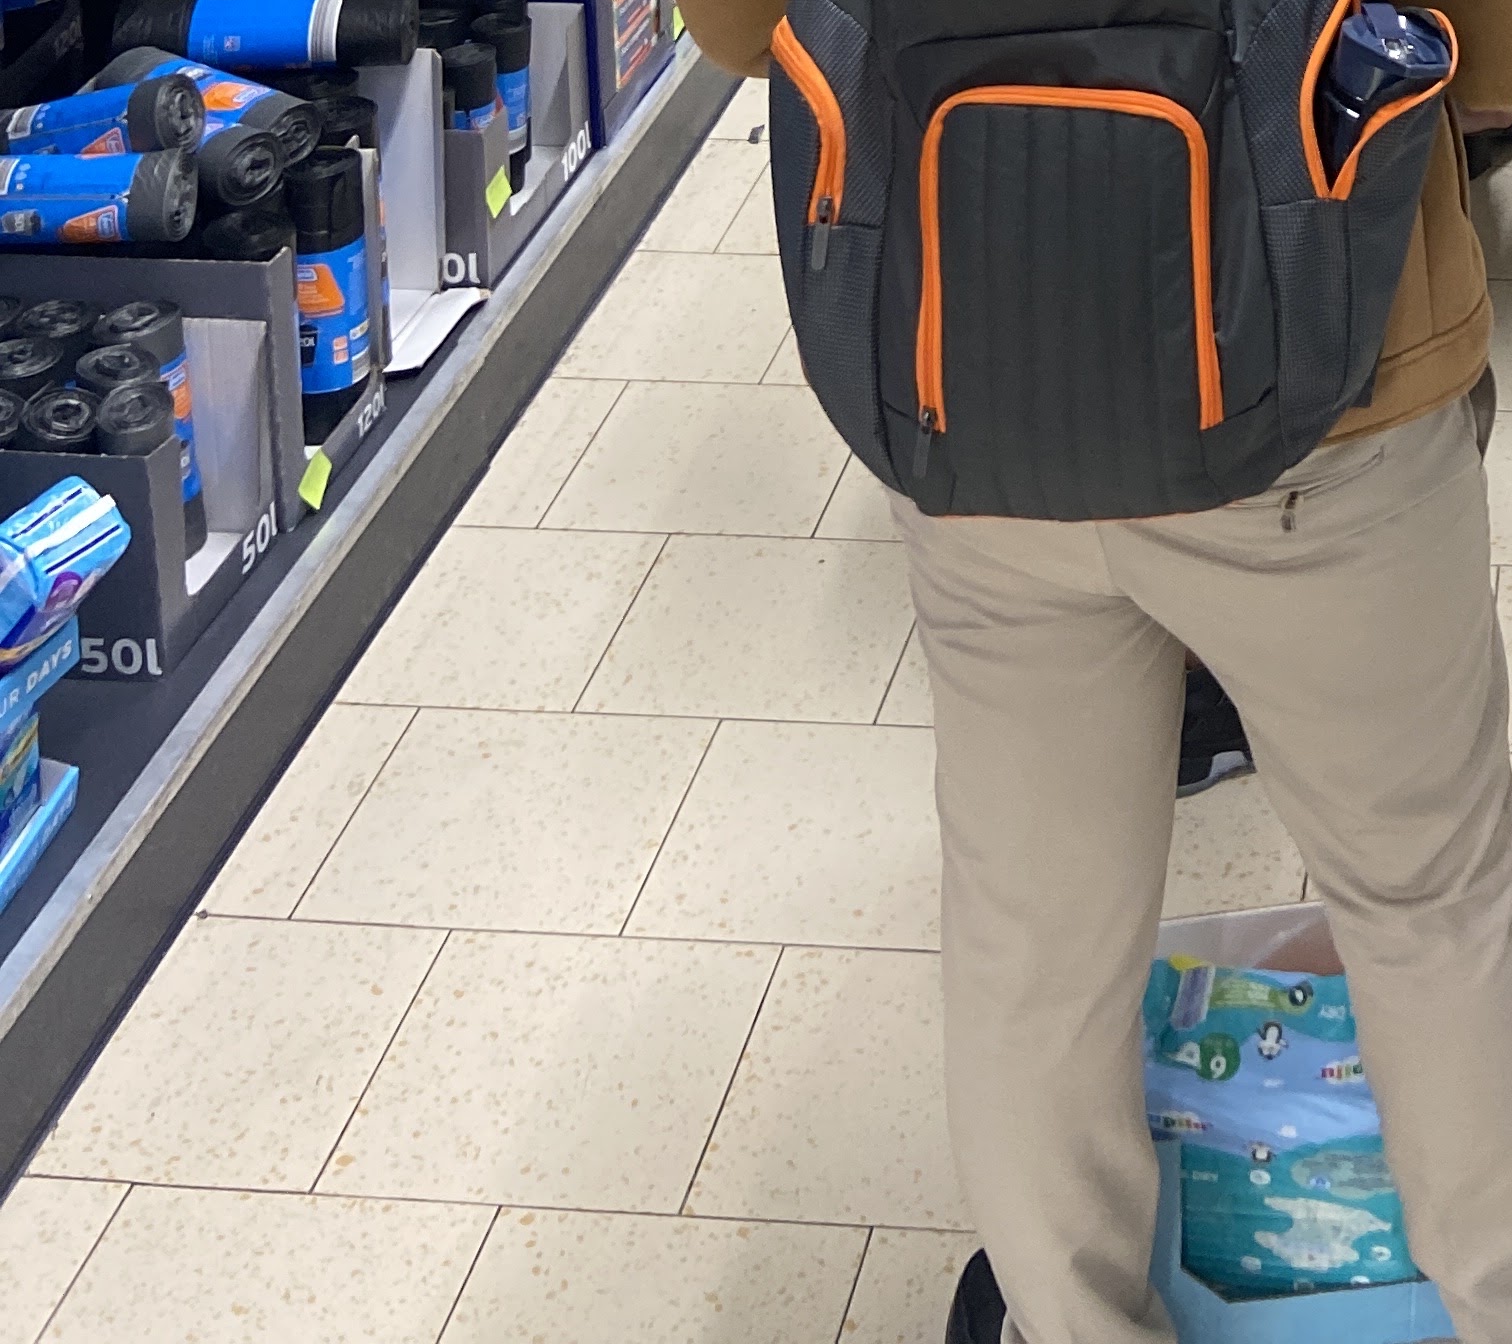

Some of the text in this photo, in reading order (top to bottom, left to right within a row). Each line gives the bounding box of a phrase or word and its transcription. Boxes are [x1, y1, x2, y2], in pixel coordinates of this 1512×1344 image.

[560, 120, 592, 181] 100l
[241, 502, 278, 575] 50l
[25, 637, 73, 694] DAYS
[81, 637, 163, 676] 50l
